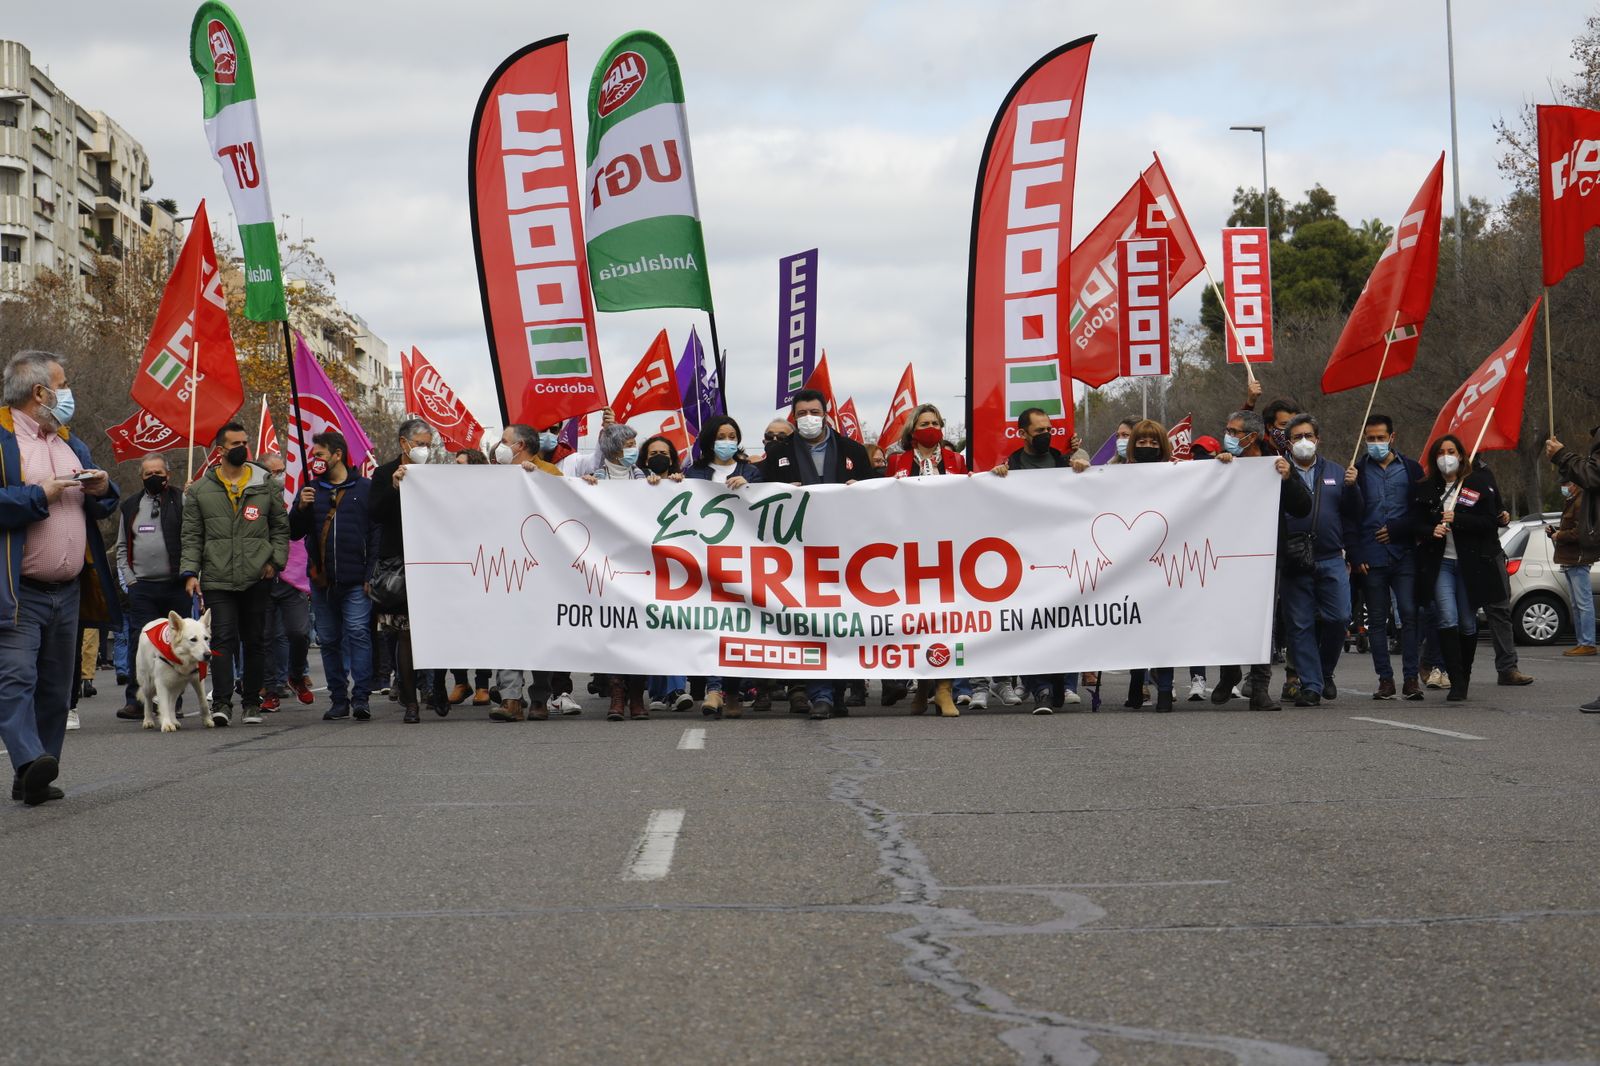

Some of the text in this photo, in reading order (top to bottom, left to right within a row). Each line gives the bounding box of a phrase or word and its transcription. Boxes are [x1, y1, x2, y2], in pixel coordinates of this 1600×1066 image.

[498, 92, 584, 323] CCOO
[1004, 99, 1072, 359] CCOO
[789, 258, 806, 366] CCOO
[1126, 240, 1161, 375] CCOO
[1231, 234, 1264, 355] CCOO
[535, 376, 595, 394] Córdoba
[652, 491, 810, 544] ES TU
[651, 537, 1023, 609] DERECHO
[557, 595, 1142, 638] POR UNA SANIDAD PÚBLICA DE CALIDAD EN ANDALUCÍA
[724, 642, 803, 664] CCOO
[859, 644, 920, 669] UGT
